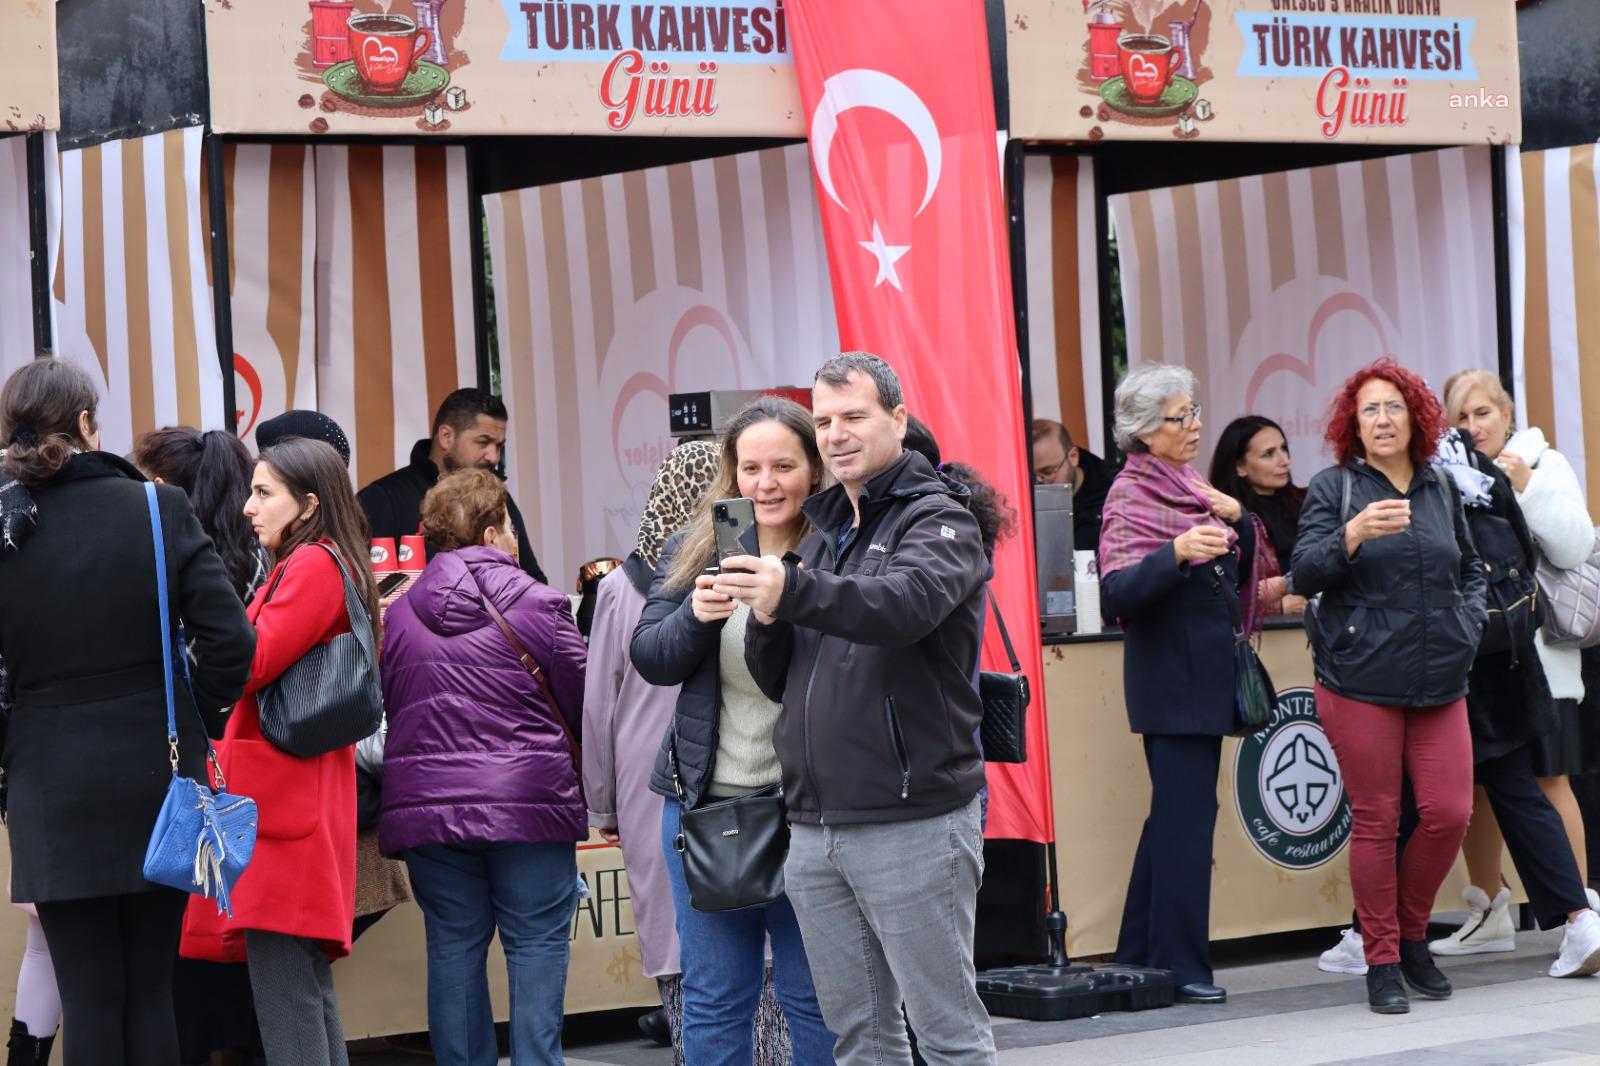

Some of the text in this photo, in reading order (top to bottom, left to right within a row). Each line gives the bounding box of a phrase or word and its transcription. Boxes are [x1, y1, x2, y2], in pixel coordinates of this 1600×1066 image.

[520, 0, 788, 54] TÜRK KAHVESİ
[1252, 17, 1463, 72] TÜRK KAHVESİ
[599, 48, 718, 130] Günü
[1315, 66, 1408, 138] Günü
[1253, 818, 1282, 847] cafe
[568, 868, 635, 941] AFE
